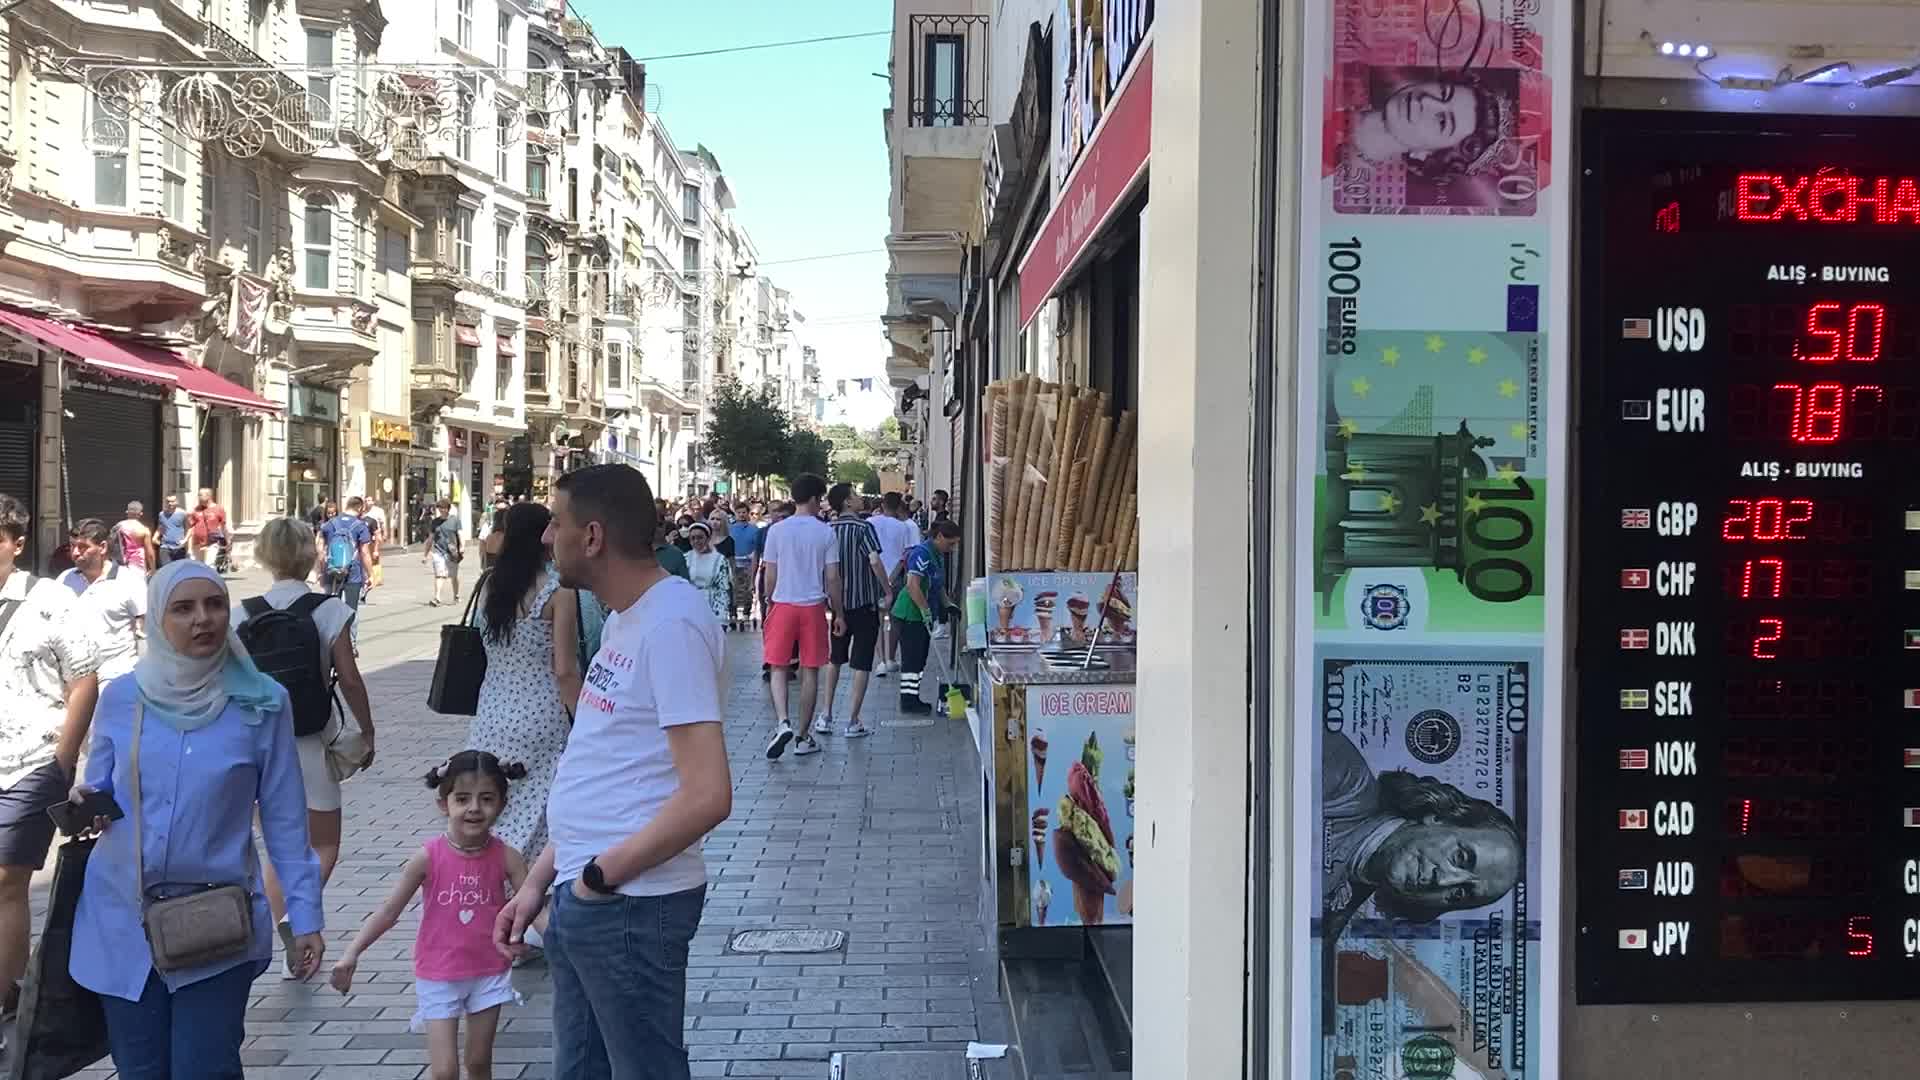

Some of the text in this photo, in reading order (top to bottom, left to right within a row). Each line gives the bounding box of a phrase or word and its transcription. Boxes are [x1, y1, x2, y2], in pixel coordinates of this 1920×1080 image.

[1737, 174, 1920, 223] EXCHA
[1329, 236, 1361, 295] 100
[1767, 265, 1806, 284] ALIŞ
[1821, 266, 1890, 283] BUYING
[1342, 296, 1356, 355] EURO
[1656, 305, 1706, 353] USD
[1656, 388, 1705, 432] EUR
[1741, 462, 1780, 481] ALIŞ
[1795, 462, 1863, 479] BUYING
[1656, 501, 1698, 537] GBP
[1465, 475, 1535, 604] 100
[1655, 561, 1697, 597] CHF
[1742, 559, 1783, 598] 17
[1655, 621, 1697, 657] DKK
[1753, 619, 1783, 659] 2
[1326, 671, 1344, 733] 100
[1457, 674, 1471, 694] B2
[1506, 668, 1526, 733] 100
[1655, 680, 1693, 716] SEK
[1041, 691, 1132, 716] ICE CREAM
[1495, 675, 1503, 807] FEDERAL RESERVE NOTE
[1655, 740, 1697, 776] NOK
[1653, 801, 1694, 837] CAD
[1742, 799, 1751, 836] 1
[437, 881, 491, 906] chou
[1653, 861, 1694, 897] AUD
[1903, 859, 1920, 894] G
[1516, 882, 1525, 913] ONE
[1653, 921, 1690, 957] JPY
[1848, 915, 1873, 956] 5
[1488, 991, 1503, 1069] STATES
[1515, 993, 1524, 1066] DOLLARS
